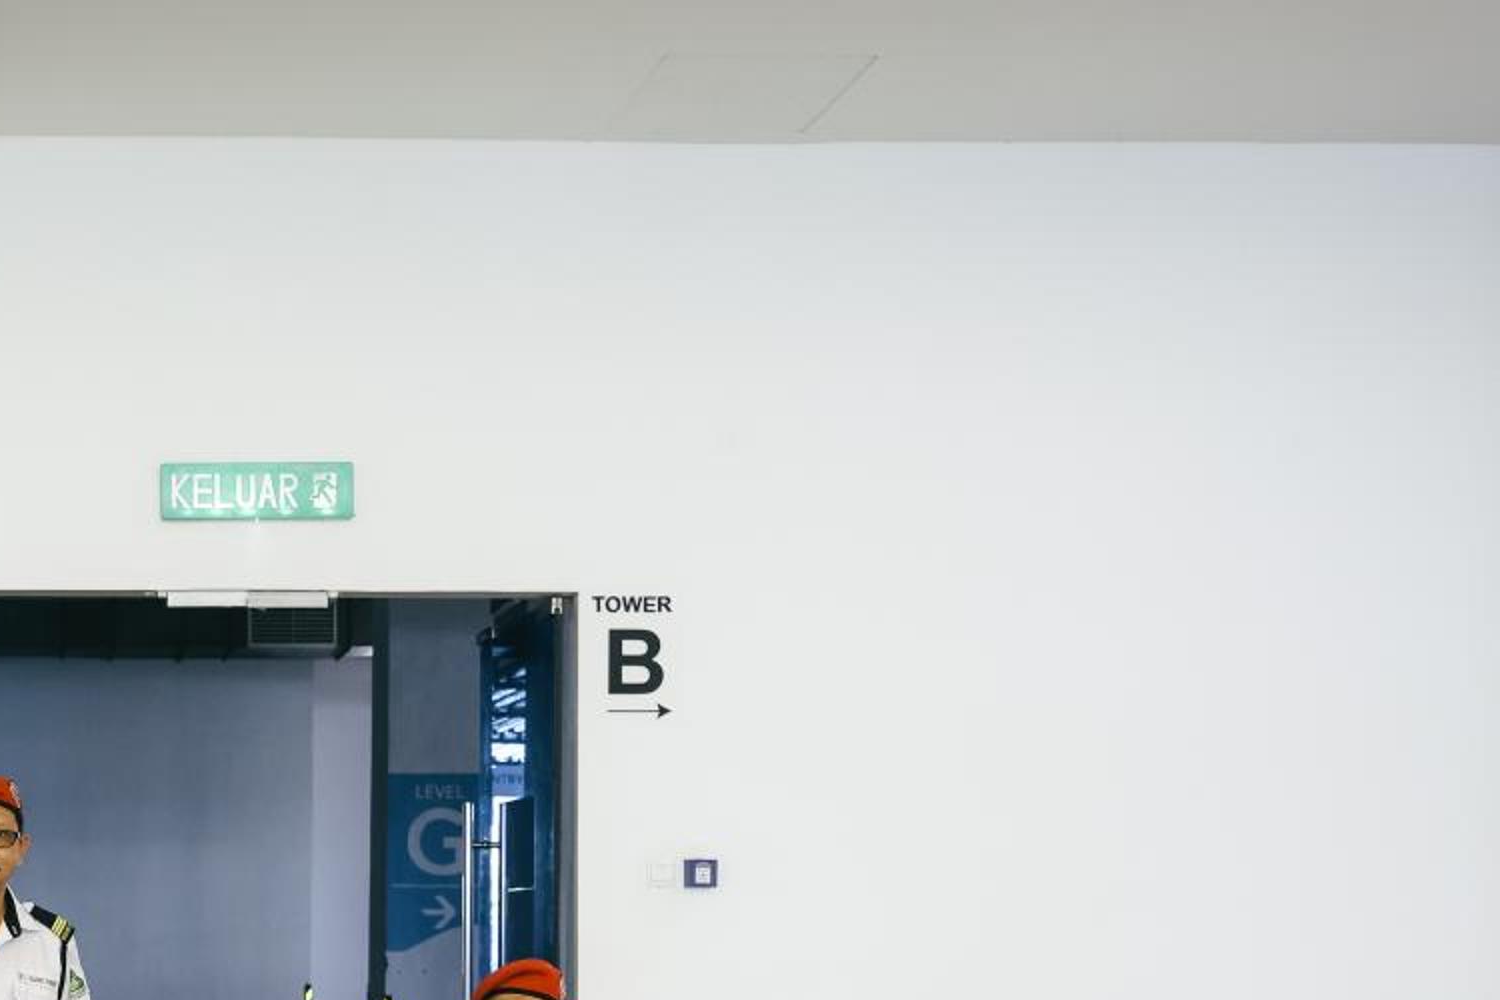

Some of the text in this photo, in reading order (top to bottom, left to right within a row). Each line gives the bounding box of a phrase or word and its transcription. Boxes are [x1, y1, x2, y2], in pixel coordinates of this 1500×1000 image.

[170, 473, 298, 509] KELUAR
[591, 594, 673, 613] TOWER
[608, 629, 664, 695] B
[414, 783, 465, 799] LEVEL
[407, 807, 467, 877] G
